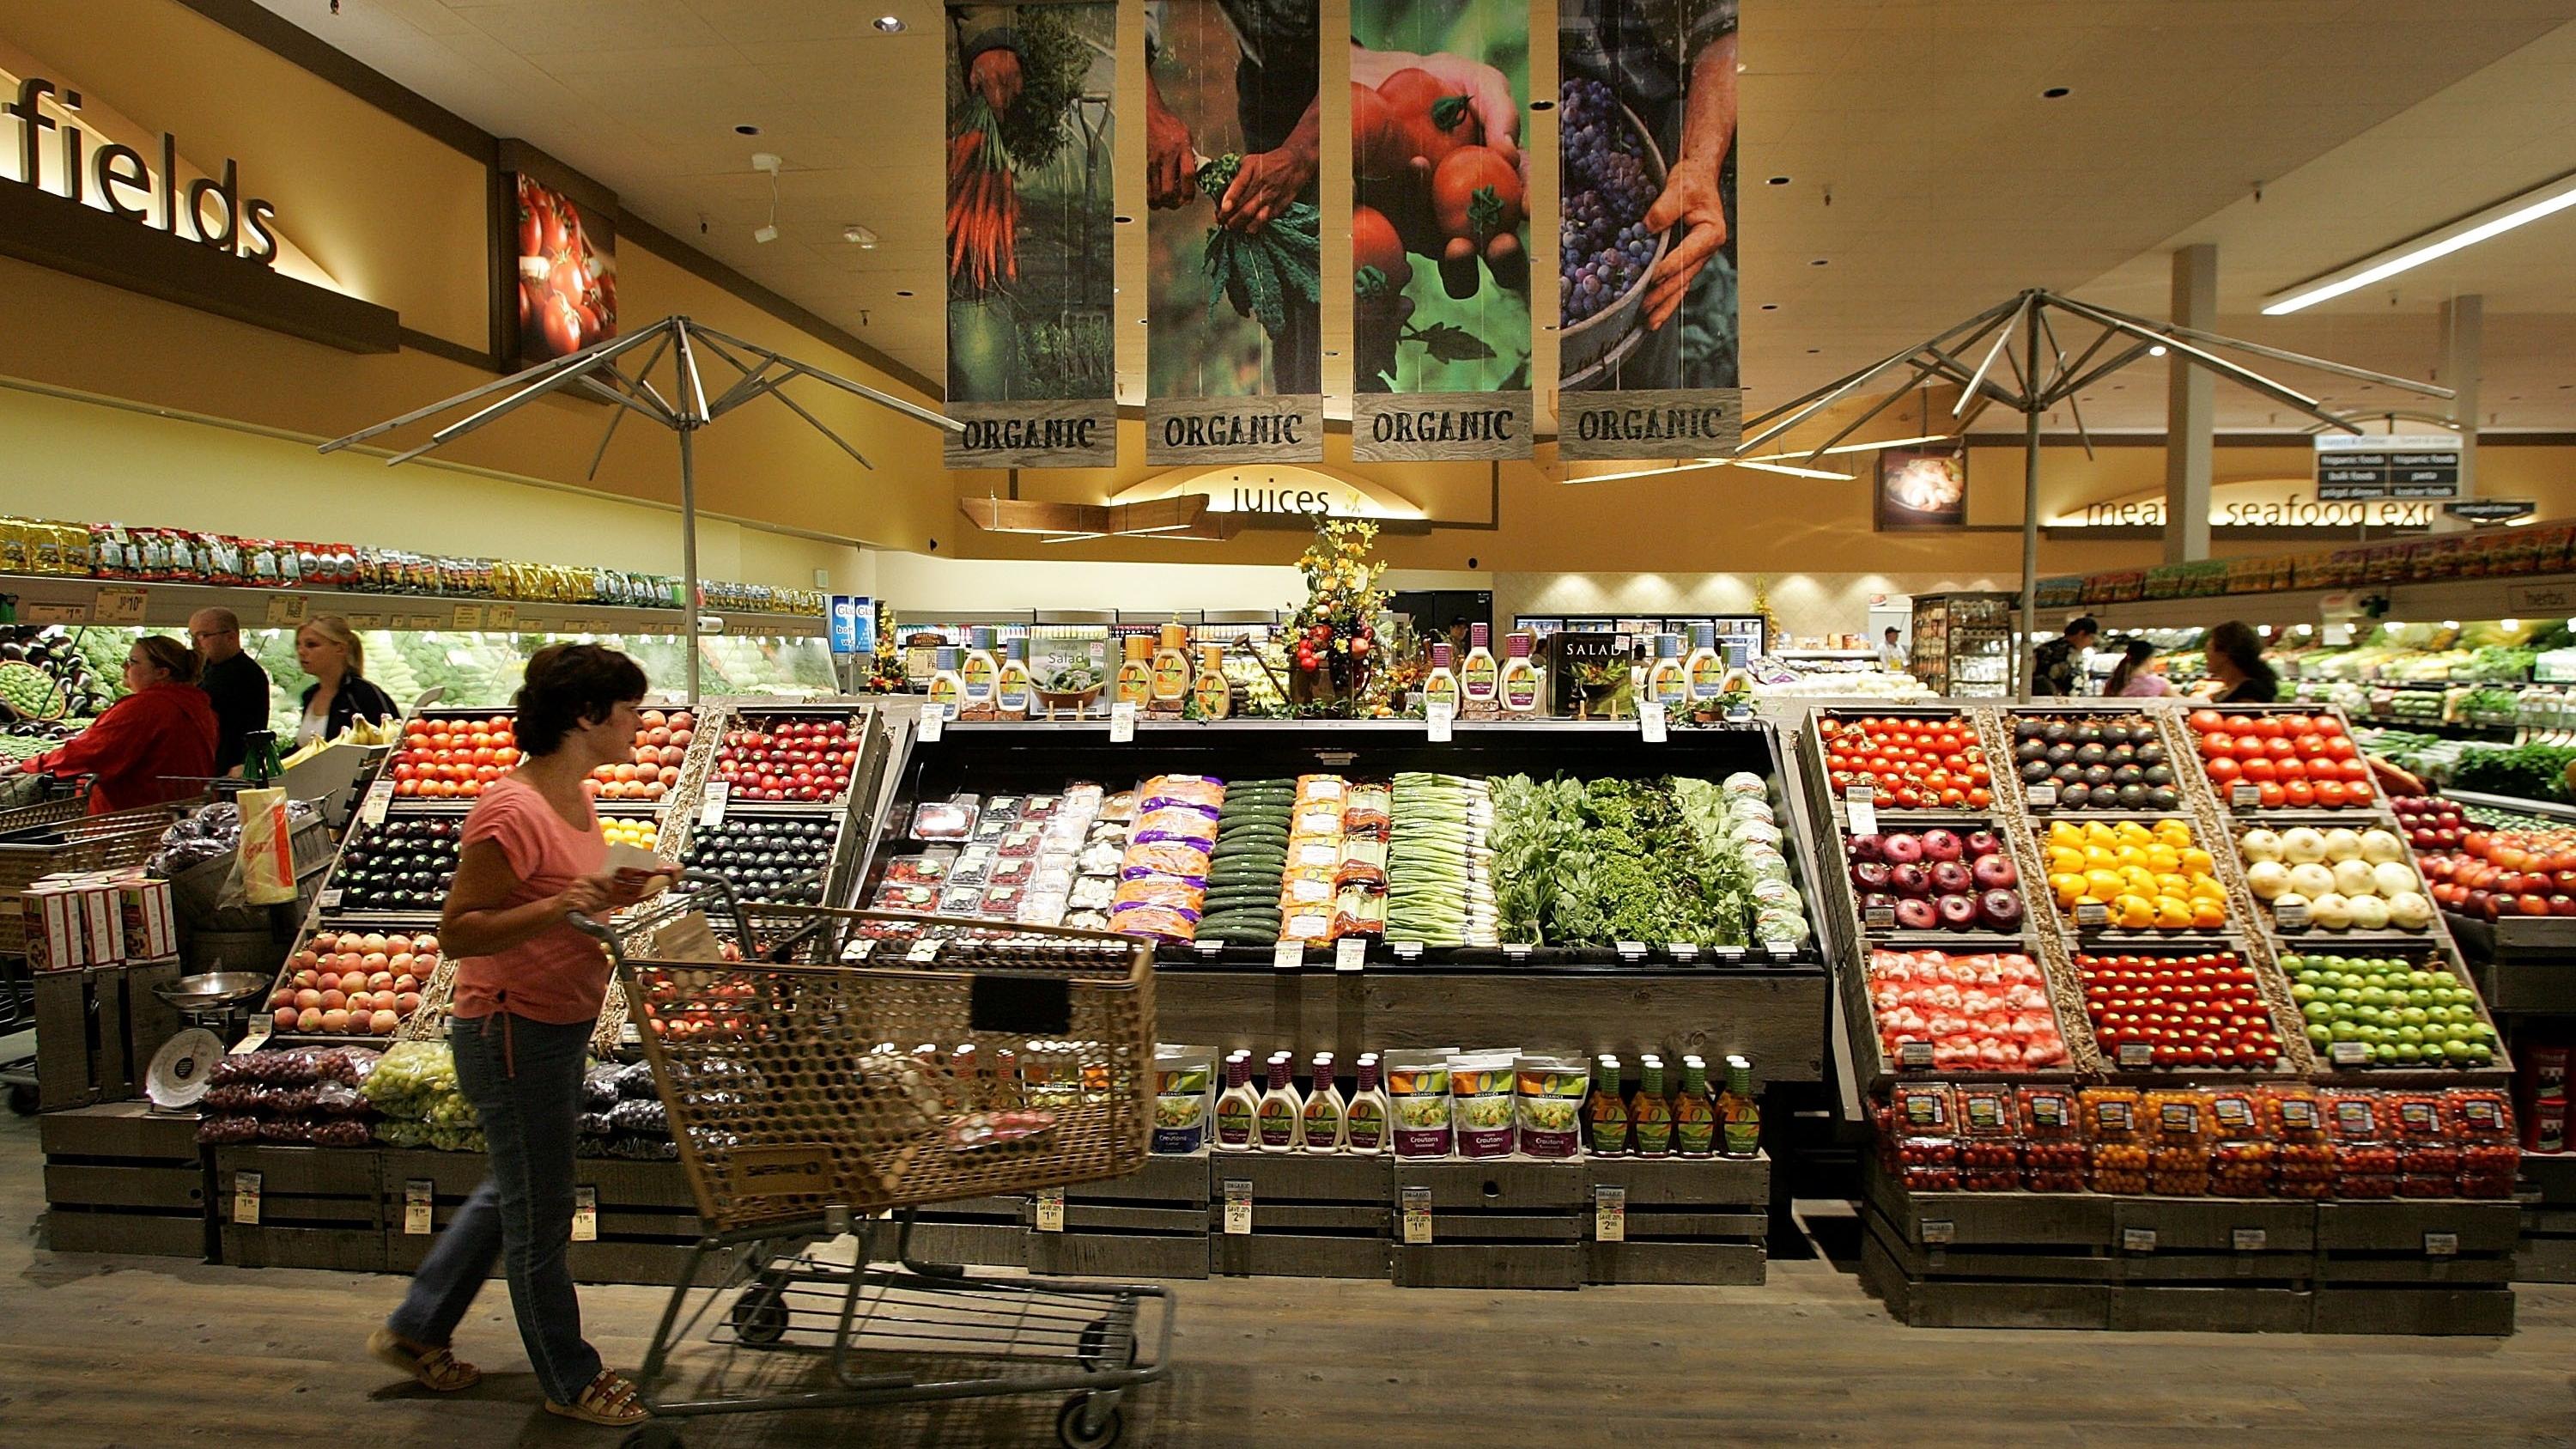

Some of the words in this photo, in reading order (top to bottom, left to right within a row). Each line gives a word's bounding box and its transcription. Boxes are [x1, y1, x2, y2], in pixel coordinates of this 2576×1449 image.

[2, 78, 277, 266] fields
[962, 418, 1096, 449] ORGANIC
[1164, 414, 1303, 447] ORGANIC
[1373, 410, 1514, 443] ORGANIC
[1578, 407, 1722, 441] ORGANIC
[1231, 476, 1329, 514] juices
[2087, 500, 2167, 526] mea
[2226, 494, 2366, 526] seafood
[1048, 652, 1084, 664] Salad
[1566, 643, 1622, 655] SALAD
